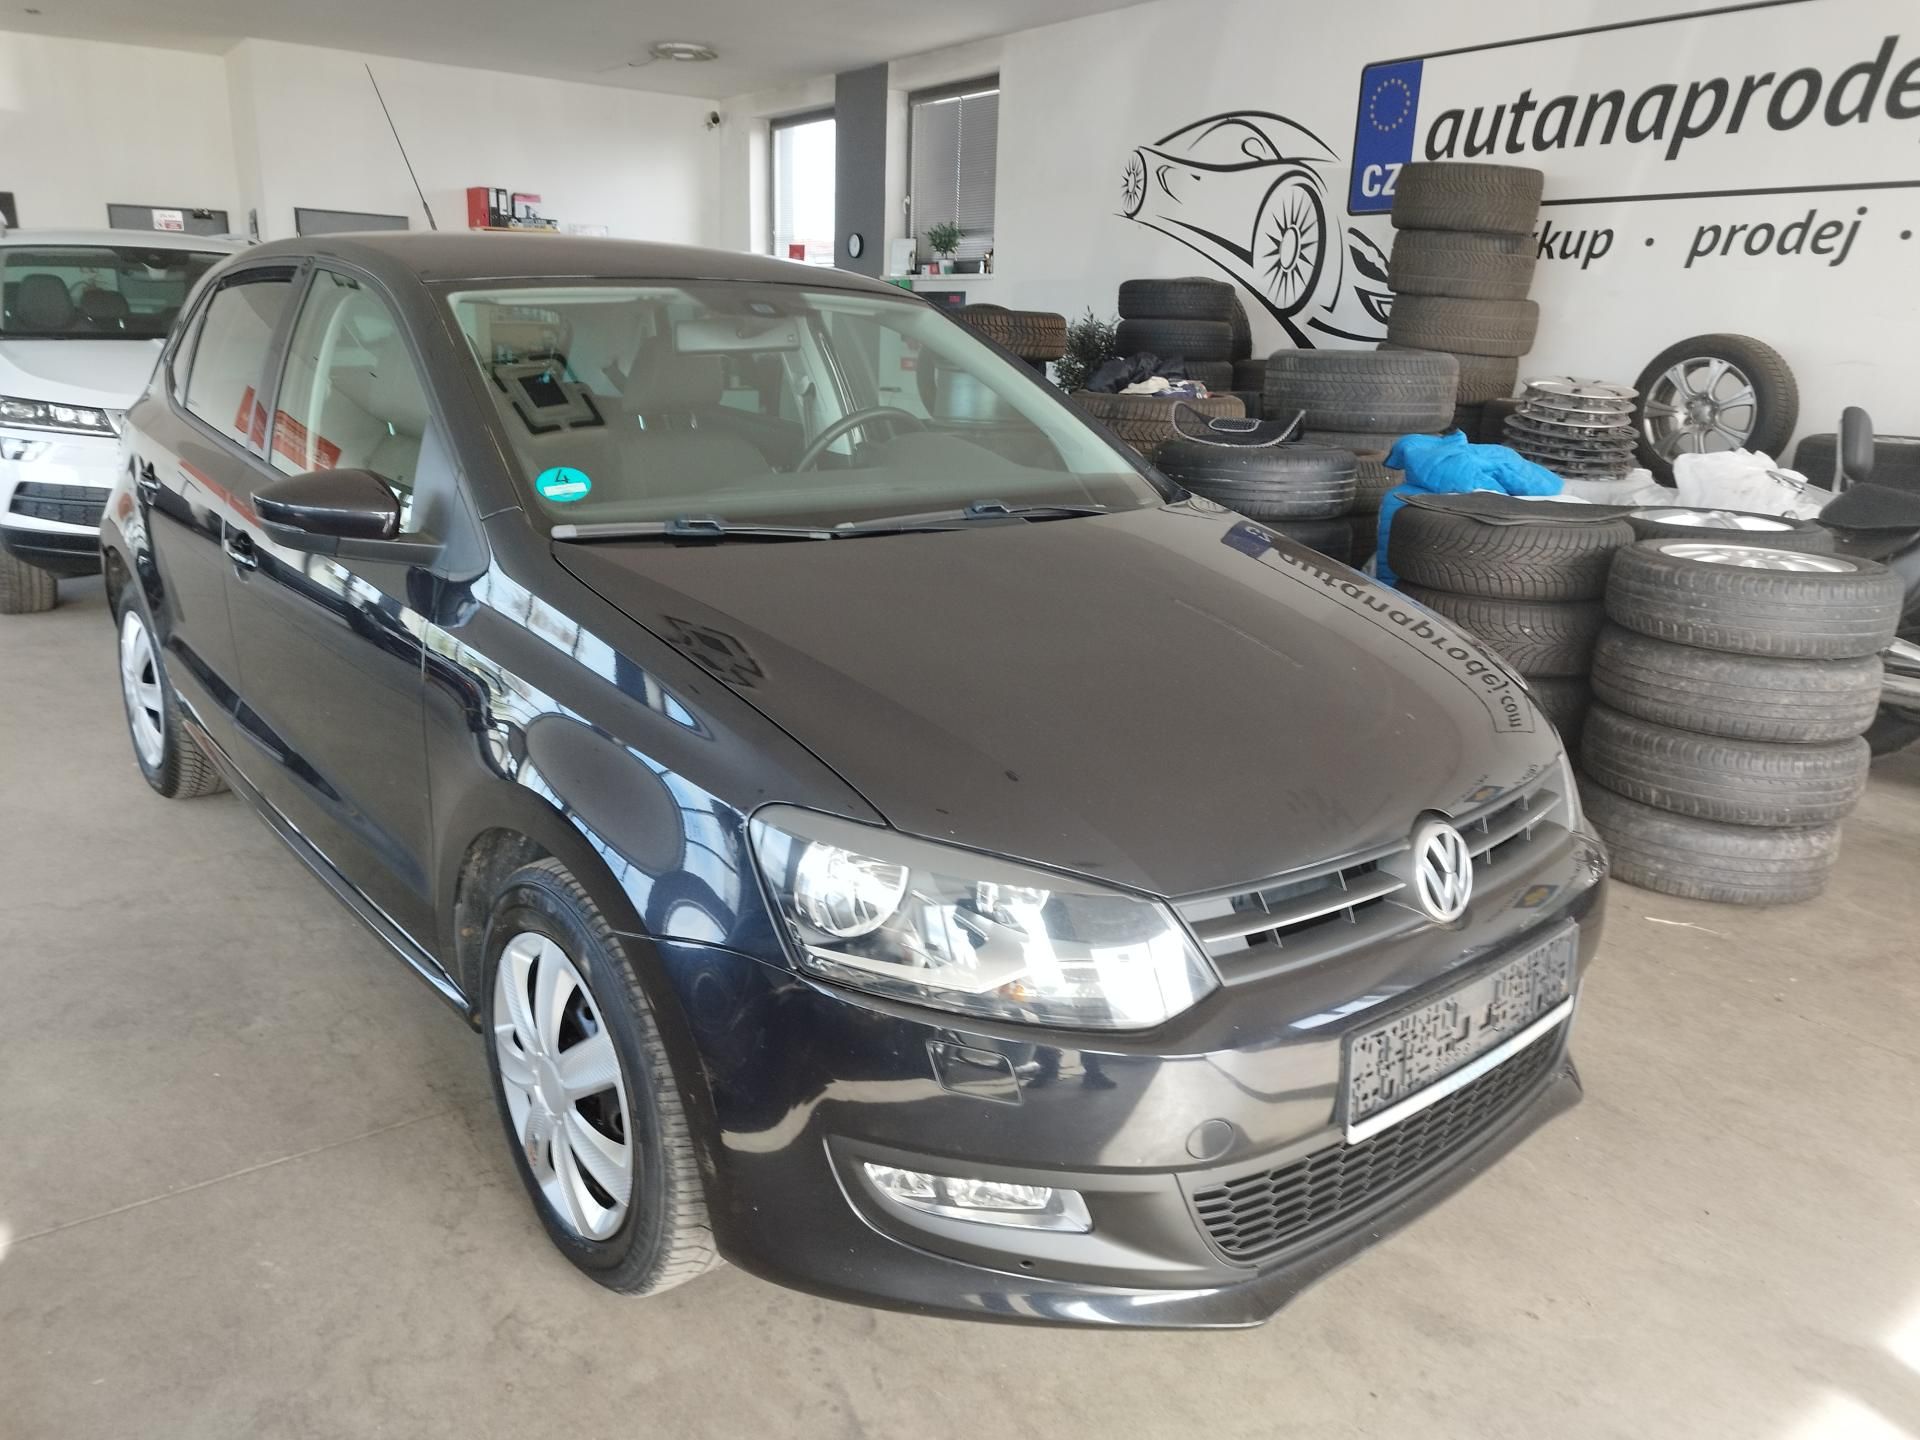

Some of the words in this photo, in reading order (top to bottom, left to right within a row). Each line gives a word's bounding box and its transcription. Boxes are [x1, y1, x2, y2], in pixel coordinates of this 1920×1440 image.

[1424, 34, 1920, 162] autanaprode
[1361, 163, 1402, 197] CZ
[1533, 219, 1614, 270] kup
[1684, 206, 1868, 268] prodej
[554, 468, 570, 484] 4
